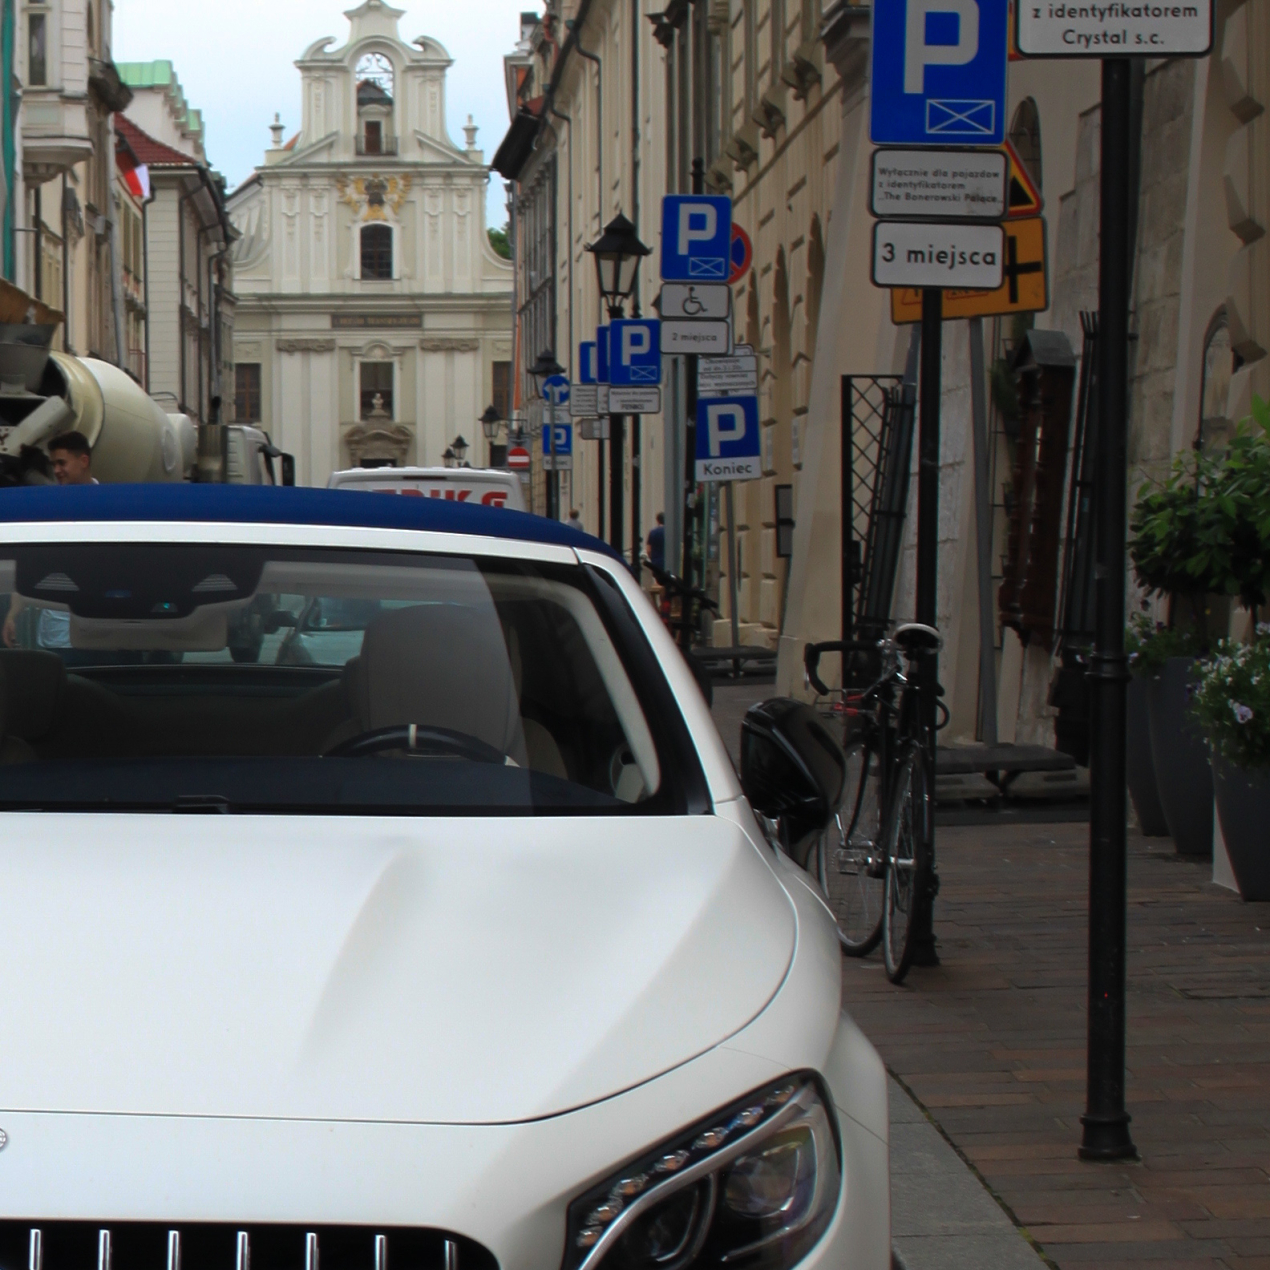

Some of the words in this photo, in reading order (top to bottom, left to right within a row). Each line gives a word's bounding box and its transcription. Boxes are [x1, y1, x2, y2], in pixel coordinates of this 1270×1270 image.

[1032, 8, 1041, 18] z
[1048, 3, 1198, 22] identyfikatorem
[1062, 29, 1127, 49] Crystal
[1135, 33, 1165, 45] s.c.
[932, 169, 949, 178] dla
[887, 180, 965, 191] identyfikatorem
[905, 192, 961, 202] Bonerowski
[676, 202, 717, 255] P
[882, 242, 895, 263] 3
[907, 245, 997, 270] miejsca
[621, 325, 650, 366] P
[672, 332, 678, 341] 2
[680, 332, 718, 343] miejsca
[707, 404, 745, 456] P
[703, 462, 752, 475] Koniec
